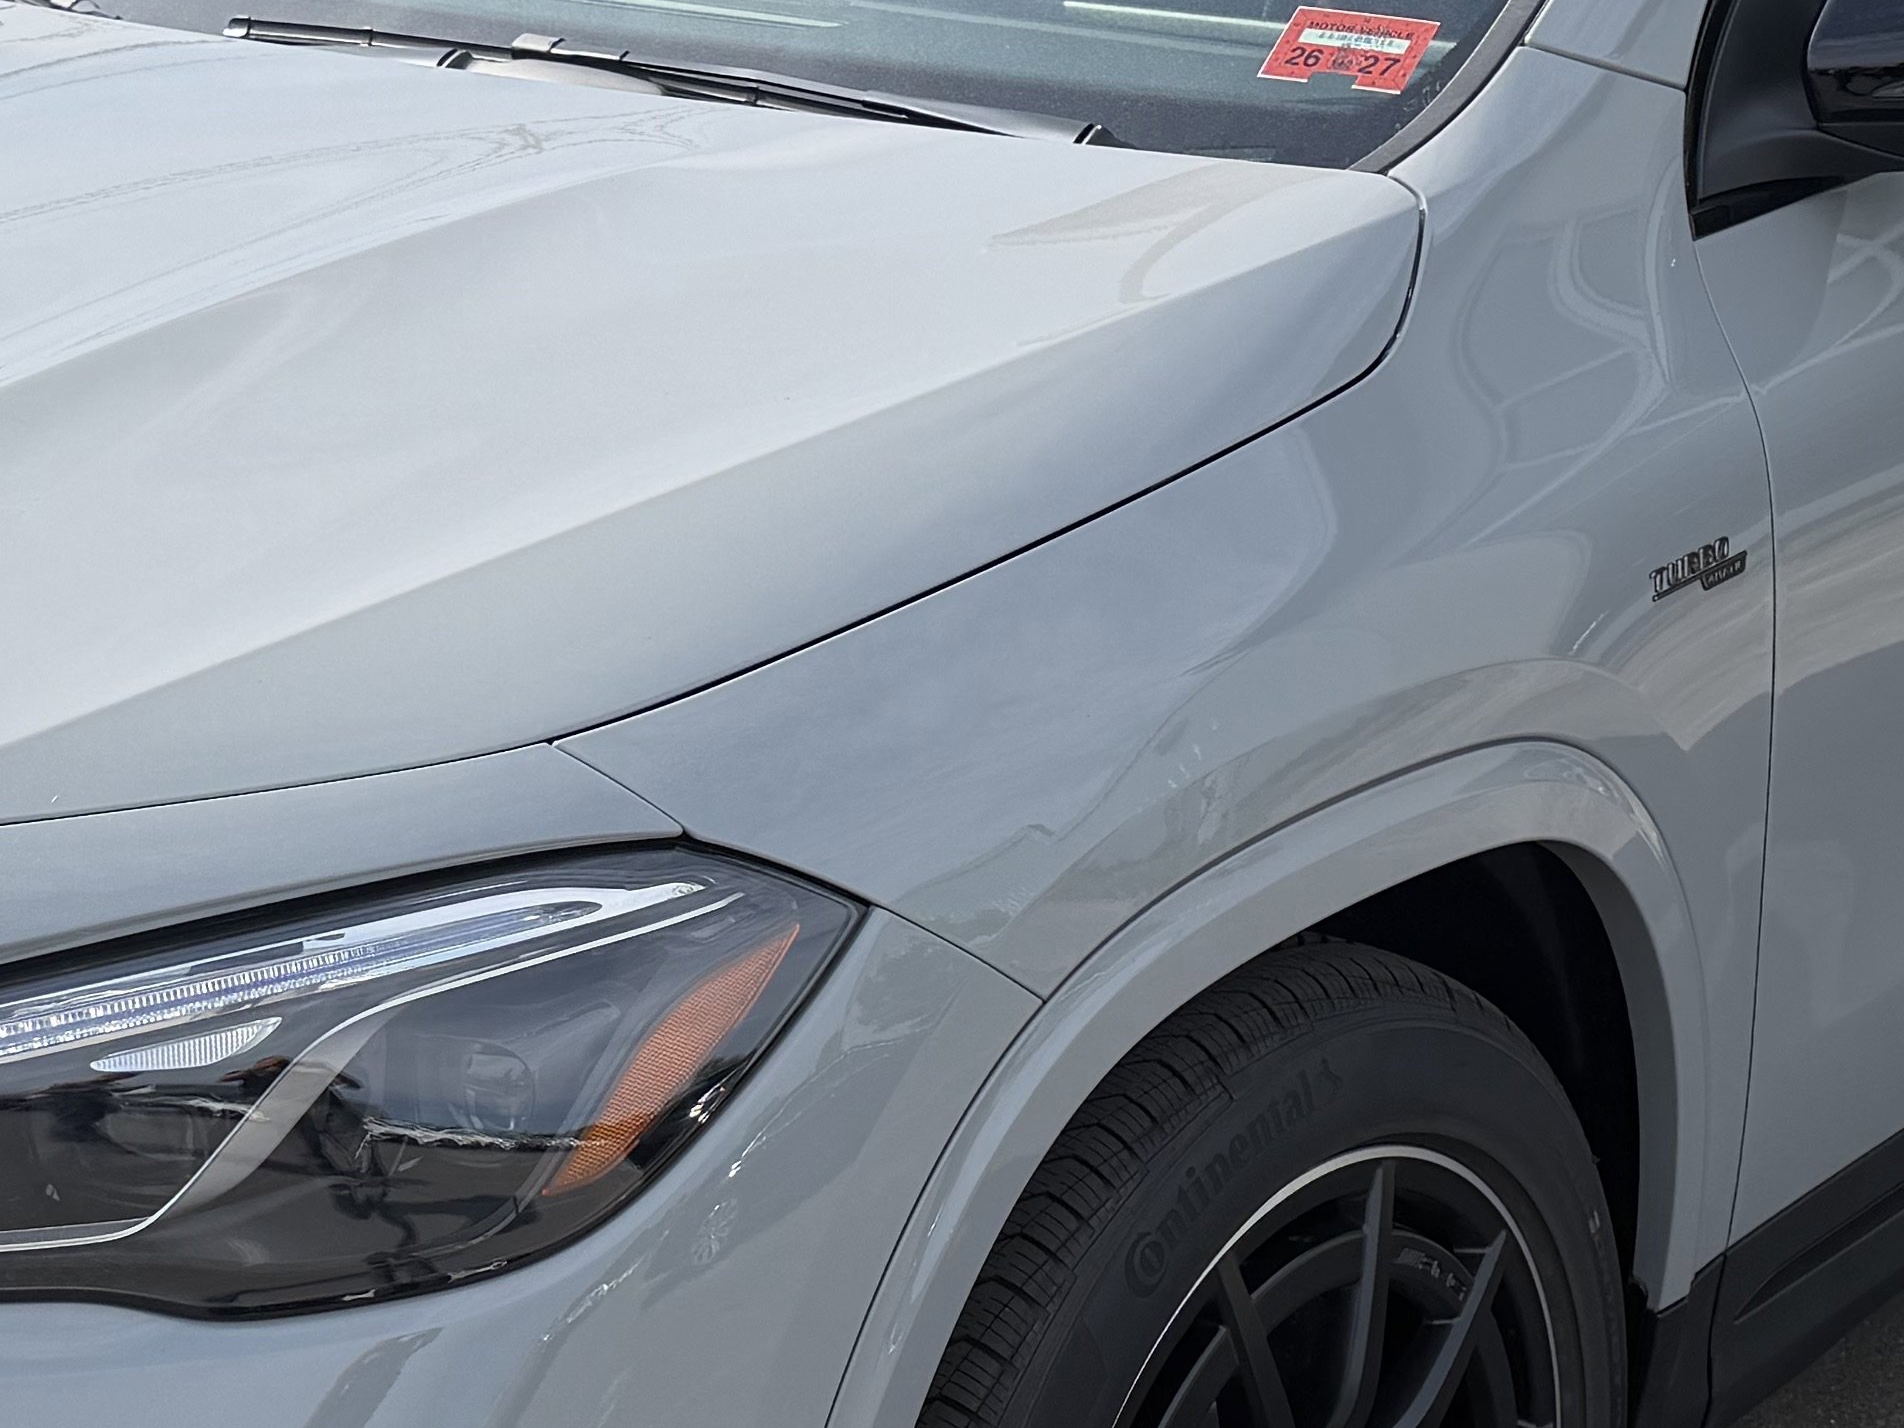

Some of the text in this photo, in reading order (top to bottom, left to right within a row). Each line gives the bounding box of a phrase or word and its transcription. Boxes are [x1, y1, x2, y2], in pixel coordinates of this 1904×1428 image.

[1284, 46, 1325, 68] 26
[1358, 55, 1402, 77] 27
[1124, 1068, 1315, 1298] Continental
